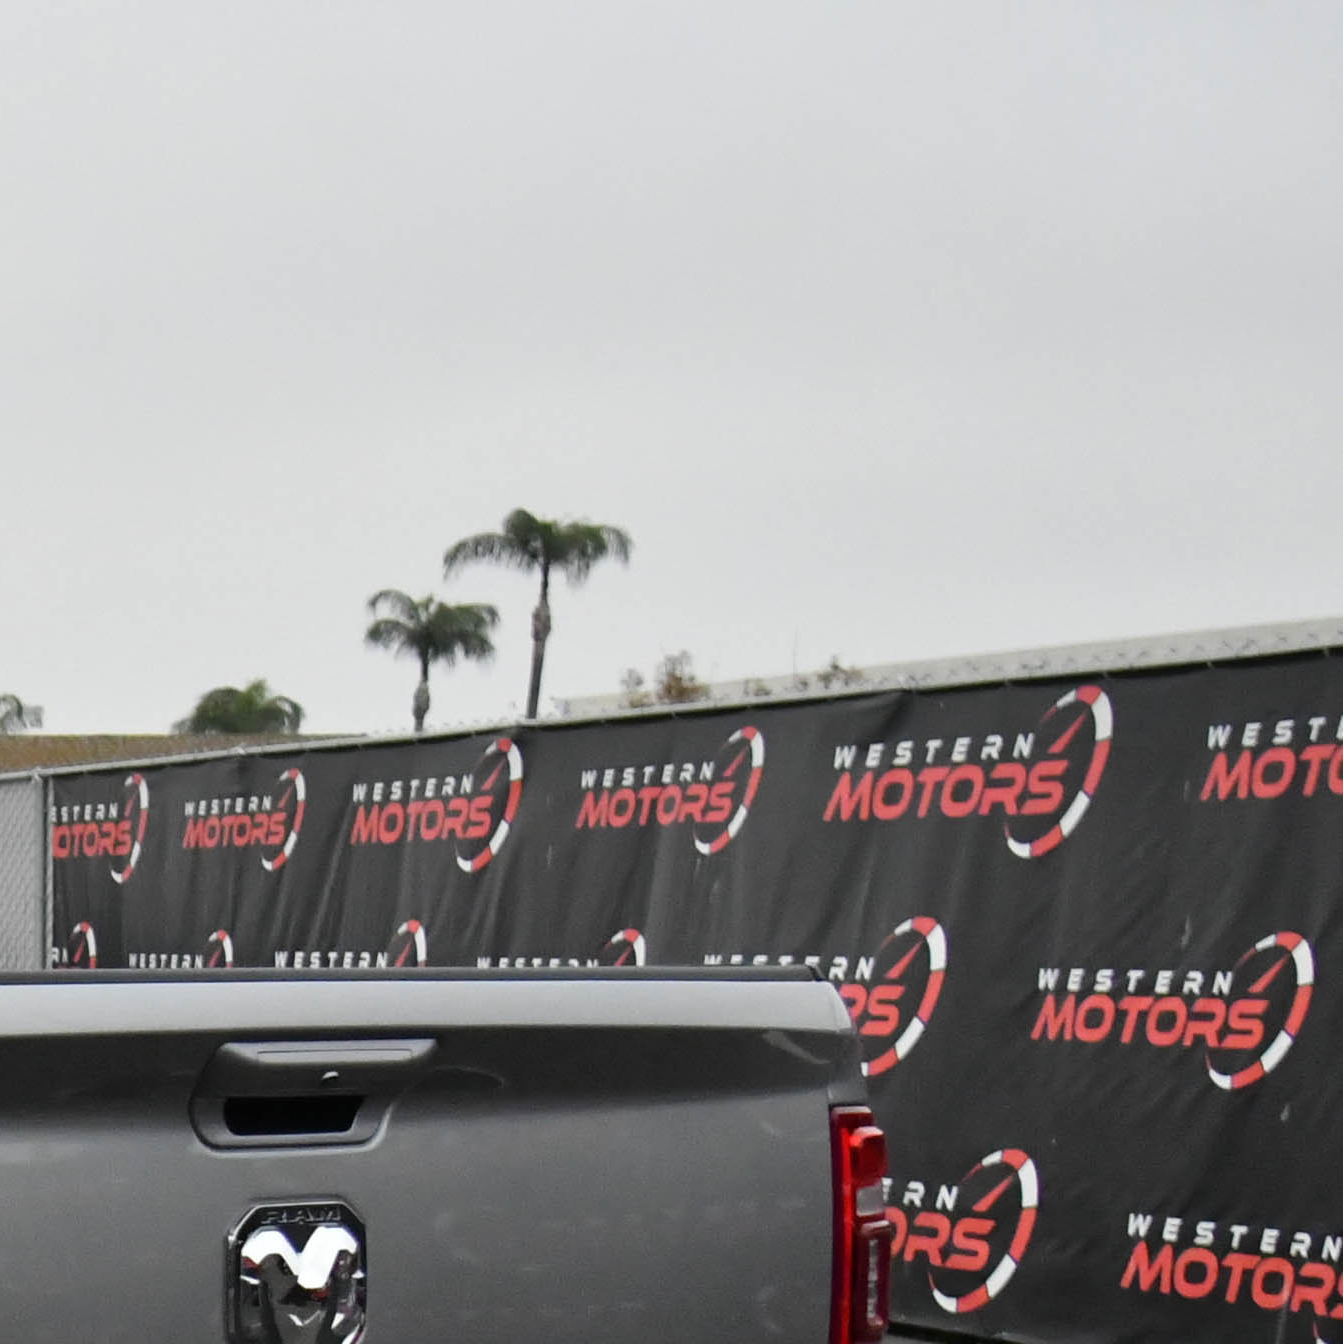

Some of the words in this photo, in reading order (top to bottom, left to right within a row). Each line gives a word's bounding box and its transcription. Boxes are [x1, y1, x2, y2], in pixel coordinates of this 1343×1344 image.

[833, 732, 1034, 770] WESTERN
[1207, 715, 1343, 750] WEST
[352, 773, 474, 803] WESTERN
[581, 761, 715, 788] WESTERN
[823, 759, 1069, 821] MOTORS
[1200, 743, 1343, 802] MOT
[50, 802, 119, 822] ESTERN
[184, 795, 272, 816] WESTERN
[351, 795, 494, 845] MOTORS
[576, 782, 736, 829] MOTORS
[52, 820, 132, 858] OTORS
[183, 812, 287, 848] MOTORS
[128, 953, 203, 968] WESTERN
[274, 951, 389, 968] WESTERN
[1038, 967, 1233, 995] WESTERN
[1030, 993, 1269, 1050] MOTORS
[1127, 1213, 1343, 1262] WESTERN
[1120, 1240, 1343, 1320] MOTOR
